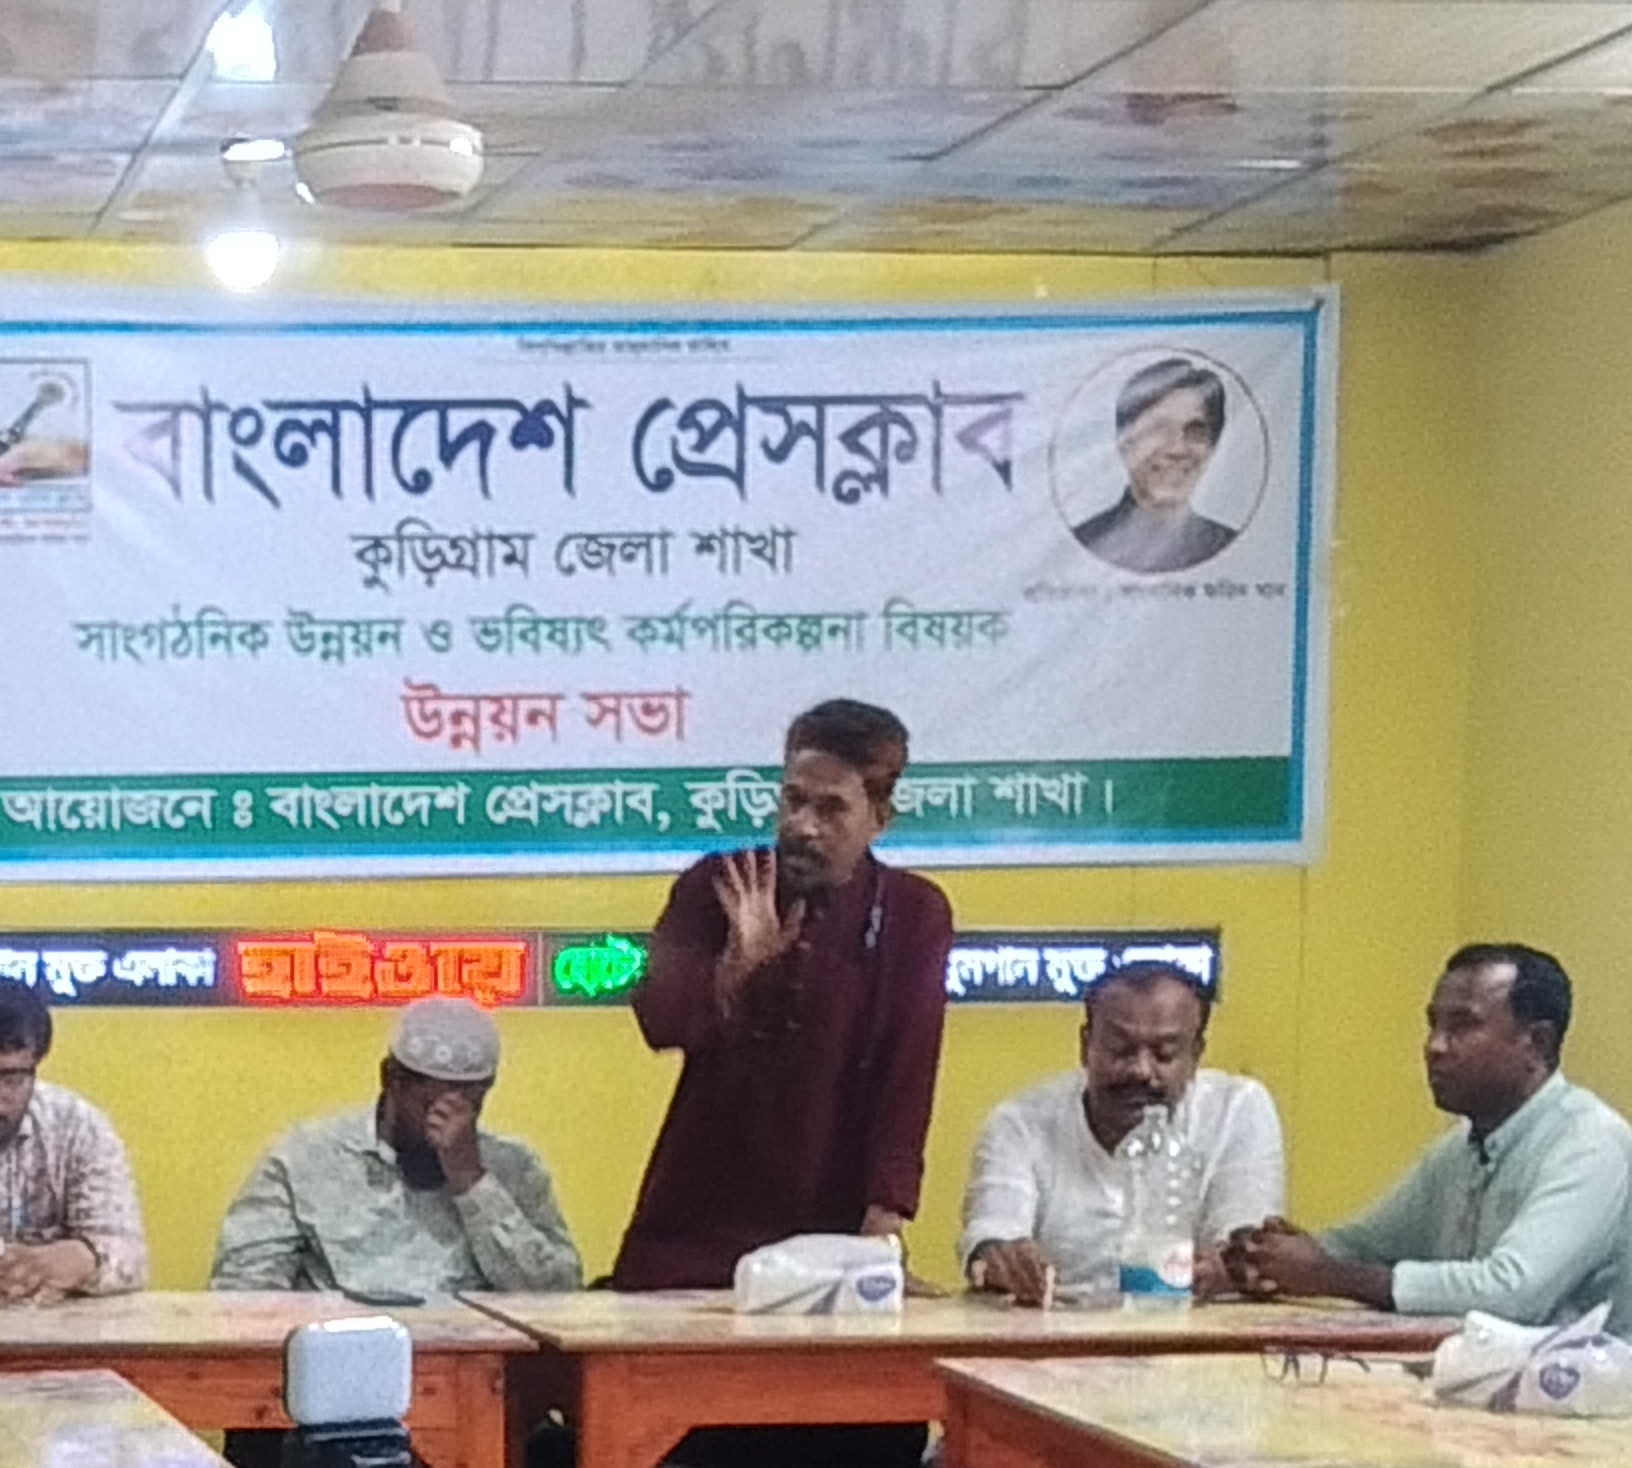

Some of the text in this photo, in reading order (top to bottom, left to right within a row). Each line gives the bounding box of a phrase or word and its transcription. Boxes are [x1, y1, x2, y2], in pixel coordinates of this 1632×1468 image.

[114, 380, 1026, 509] বাংলাদেশ প্রেসক্লাব
[351, 517, 798, 589] কুড়িগ্রাম জেলা শাখা
[73, 604, 272, 664] সাংগঠনিক
[286, 608, 404, 667] উন্নয়ন
[423, 620, 453, 654] ও
[401, 676, 691, 754] উন্নয়ন সভা
[0, 783, 218, 833] আয়োজনে
[267, 781, 470, 829] বাংলাদেশ
[889, 771, 978, 819] জলা
[991, 769, 1089, 818] শাখা
